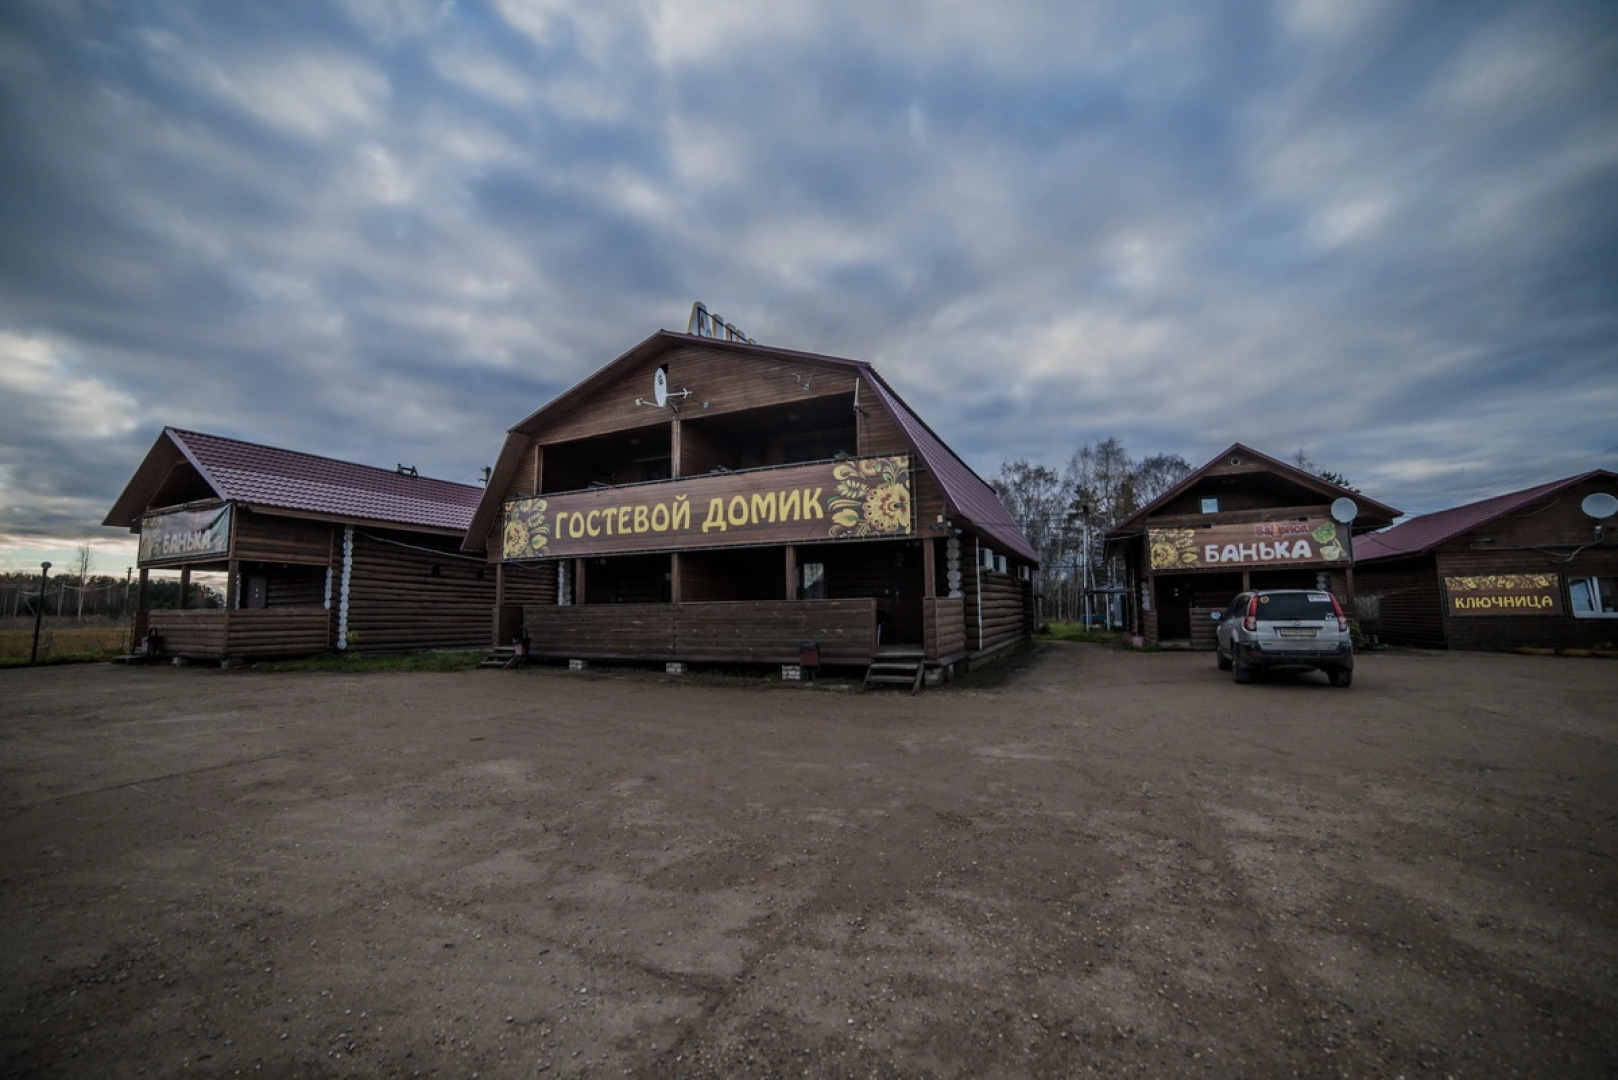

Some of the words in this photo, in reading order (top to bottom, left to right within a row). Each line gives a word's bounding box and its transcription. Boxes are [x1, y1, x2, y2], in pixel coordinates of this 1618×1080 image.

[555, 495, 690, 539] ГОСТЕВОЙ
[702, 487, 825, 533] ДОМИК
[162, 530, 211, 554] БАНЬКА
[1205, 540, 1312, 563] БАНЬКА
[1455, 596, 1553, 609] КЛЮЧНИЦА
